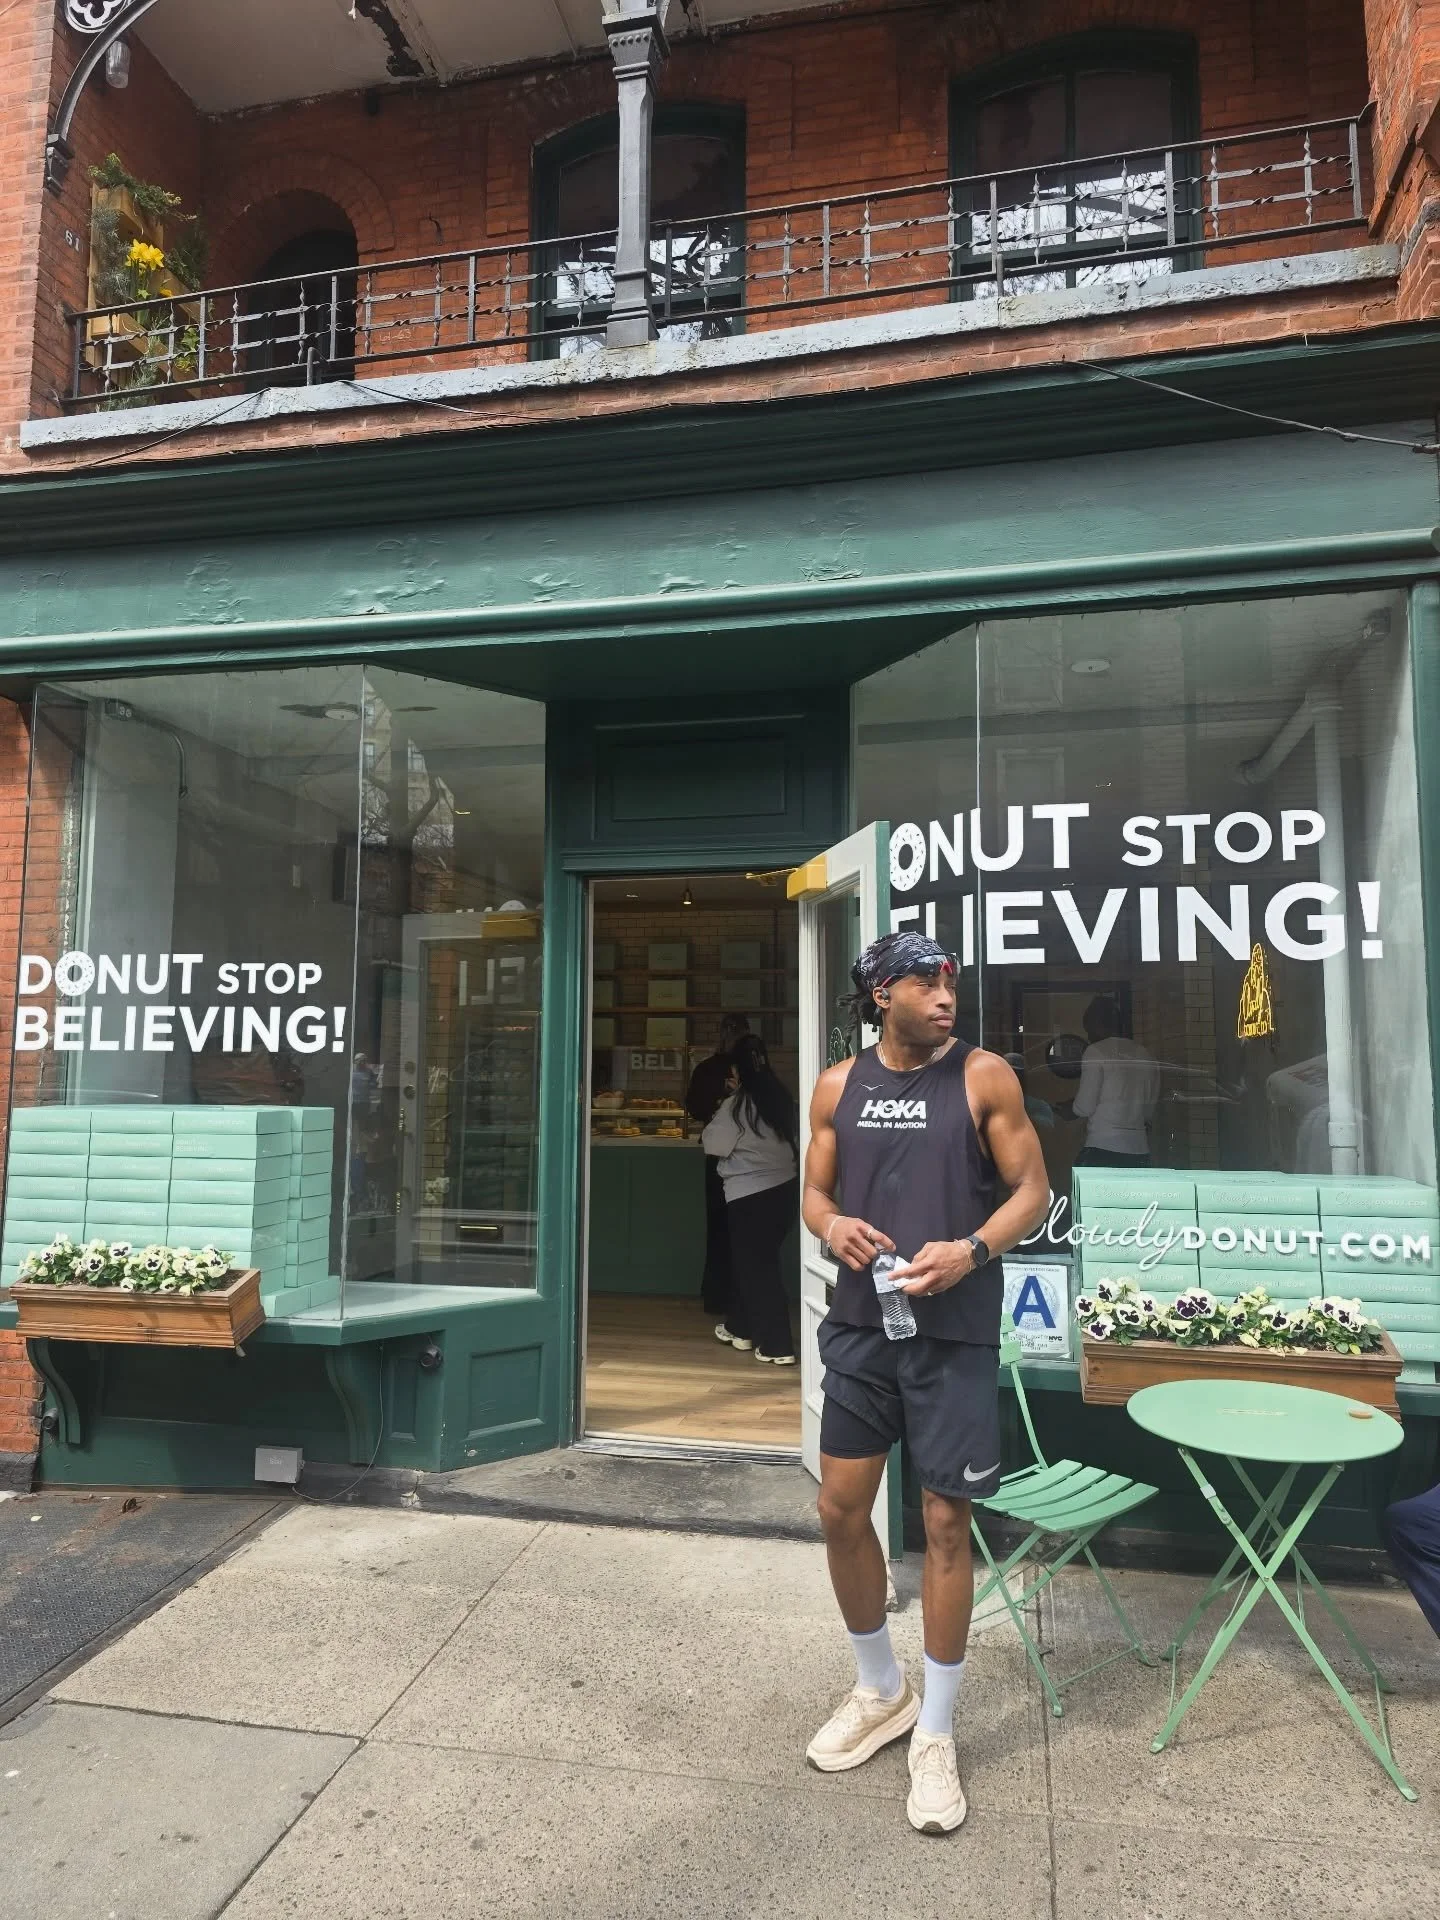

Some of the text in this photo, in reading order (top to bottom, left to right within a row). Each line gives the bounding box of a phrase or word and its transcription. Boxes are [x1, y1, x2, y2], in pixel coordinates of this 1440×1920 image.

[890, 803, 1325, 891] ONUT STOP
[18, 951, 322, 996] DONUT STOP
[15, 1006, 346, 1053] BELIEVING!
[861, 1099, 927, 1119] HOKA
[1012, 1276, 1057, 1328] A
